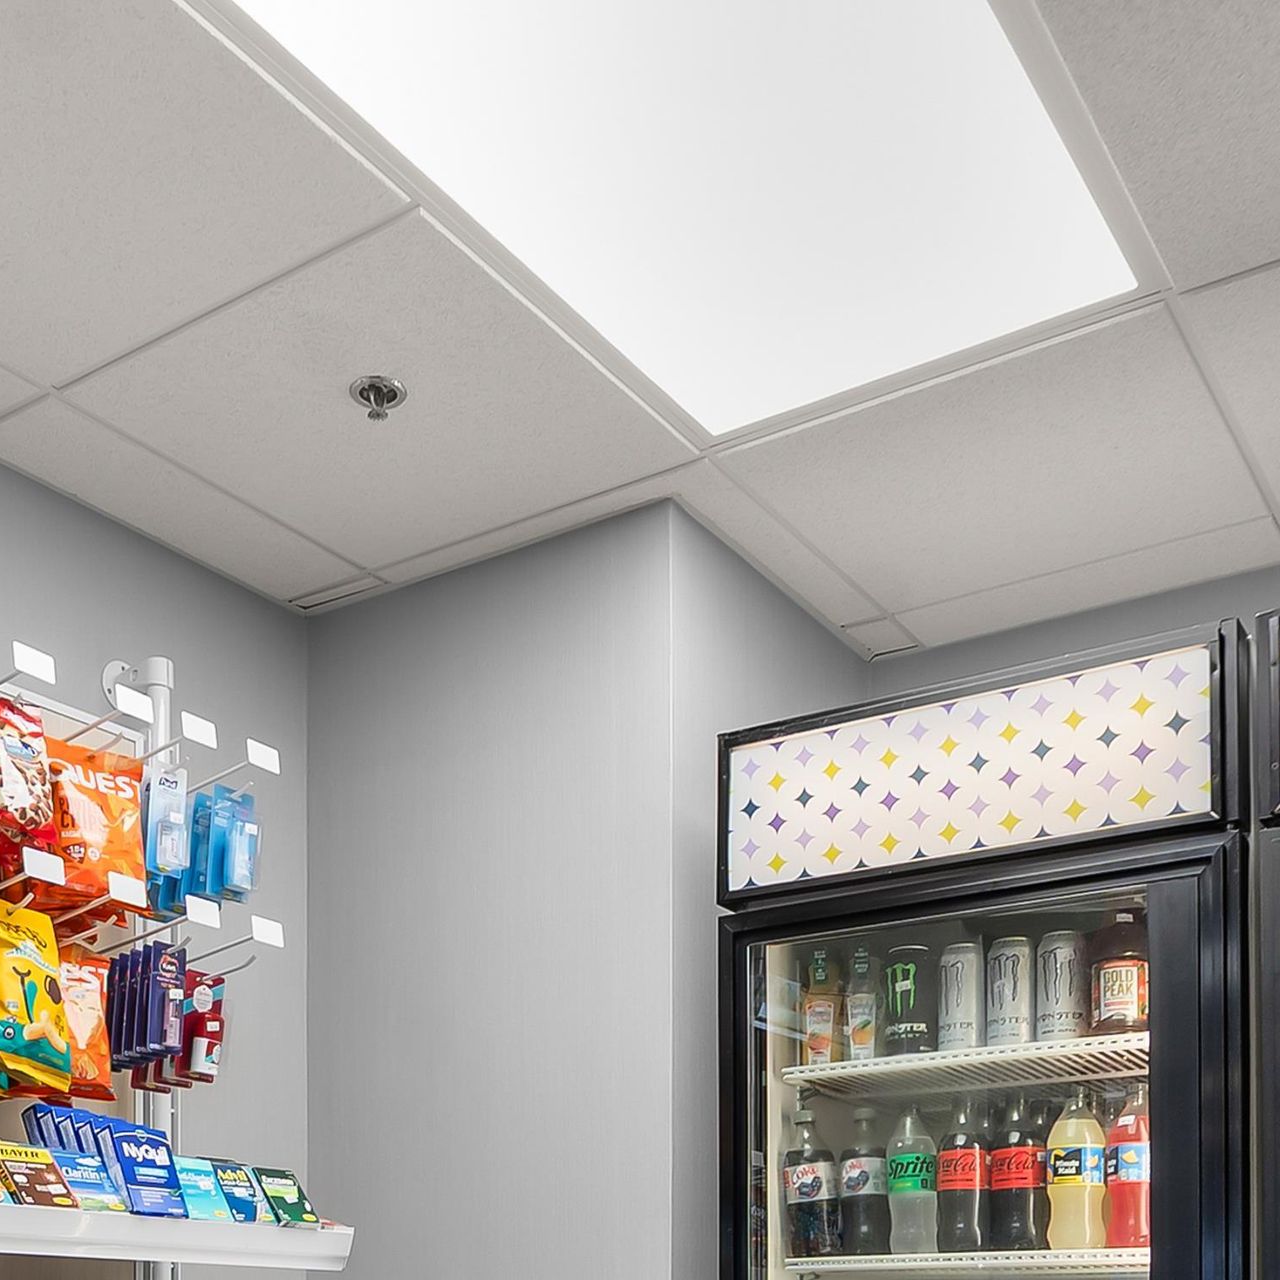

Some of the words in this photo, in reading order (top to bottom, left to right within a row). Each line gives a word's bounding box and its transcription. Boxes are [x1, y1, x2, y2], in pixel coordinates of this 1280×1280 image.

[1103, 969, 1133, 984] GOLD
[1103, 983, 1133, 997] PEAK
[0, 1148, 40, 1159] BAYER
[121, 1142, 167, 1163] NyQuil
[63, 1166, 100, 1180] Claritin
[888, 1156, 934, 1179] Sprite
[218, 1168, 247, 1182] Advil
